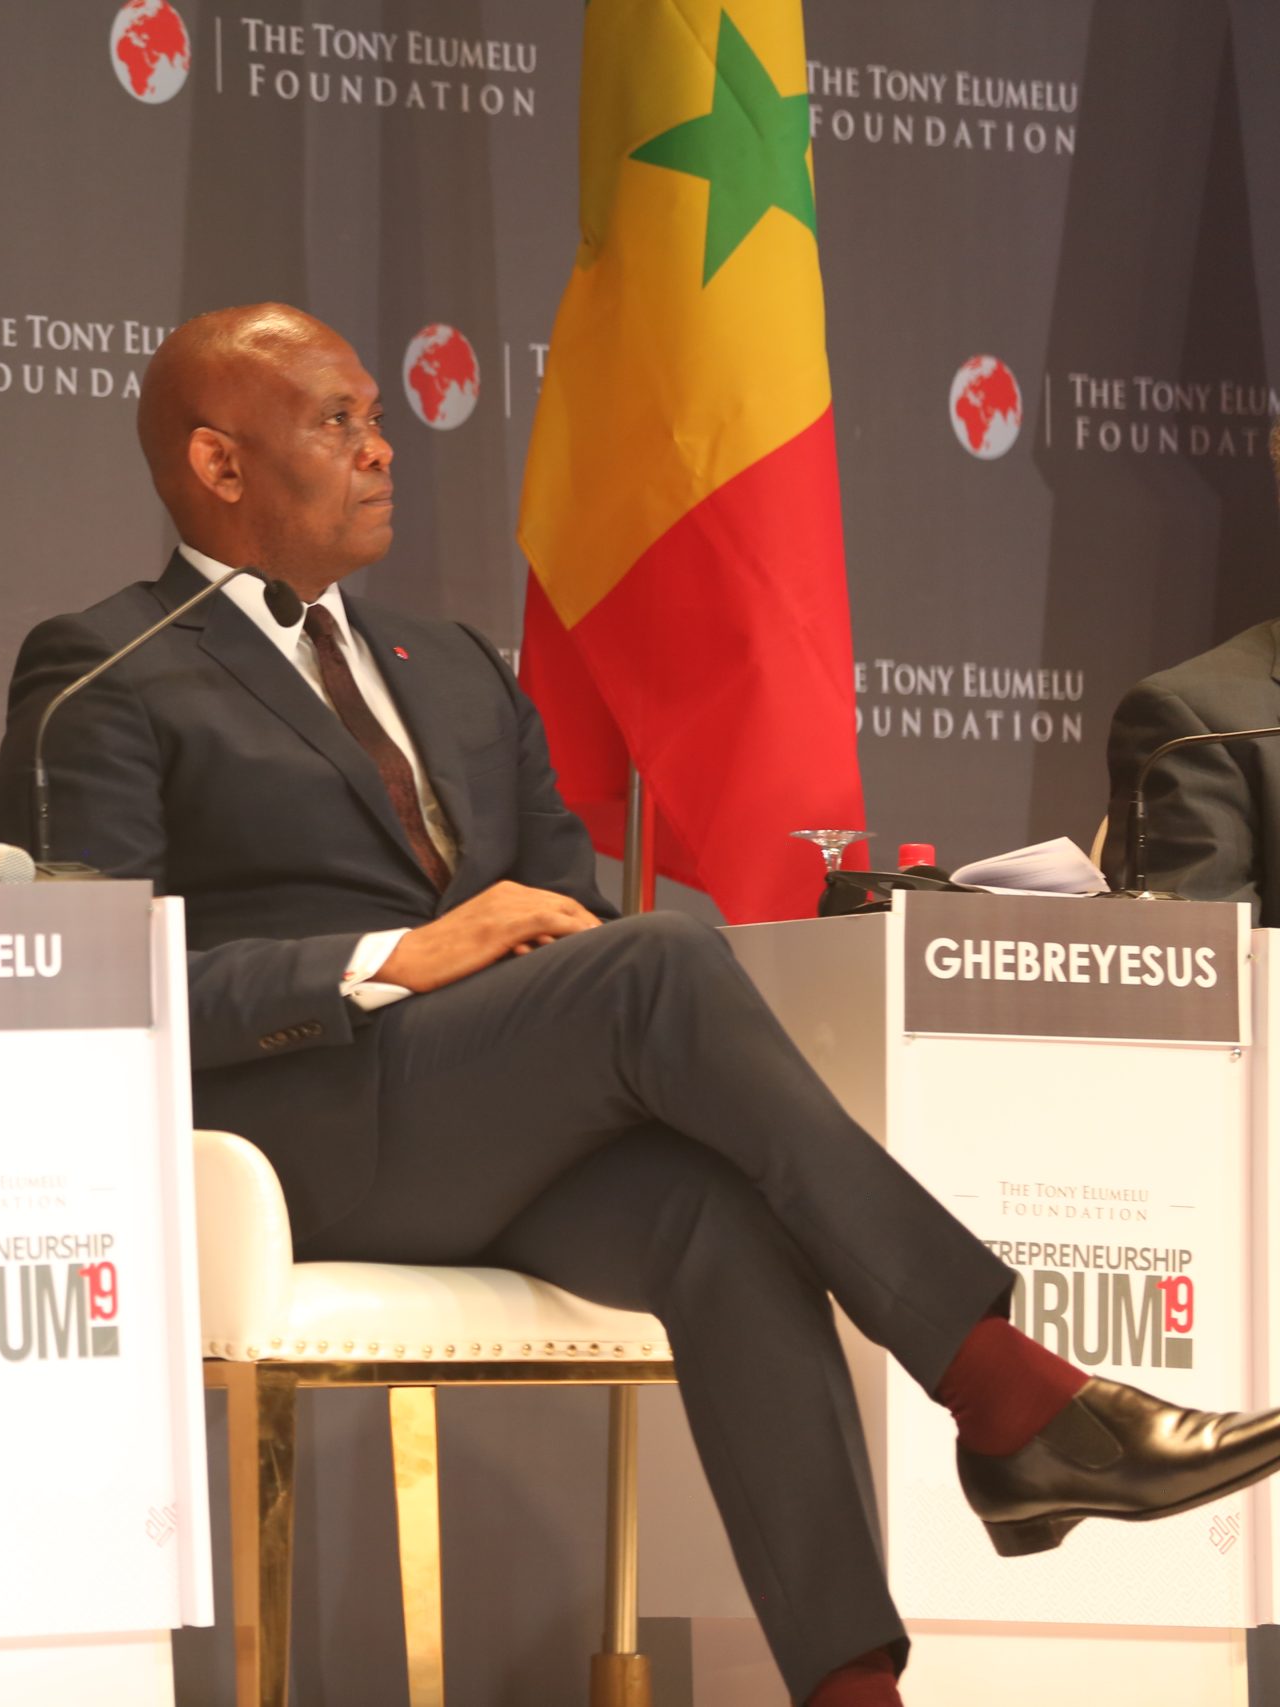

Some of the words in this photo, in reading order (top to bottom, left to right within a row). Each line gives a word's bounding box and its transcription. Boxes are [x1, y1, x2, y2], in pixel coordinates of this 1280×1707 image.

[240, 17, 306, 56] THE
[311, 22, 398, 63] TONY
[406, 30, 537, 73] ELUMELU
[248, 62, 536, 117] FOUNDATION
[806, 60, 861, 98] THE
[866, 64, 947, 104] TONY
[955, 71, 1079, 114] ELUMELU
[809, 103, 1077, 155] FOUNDATION
[25, 314, 115, 353] TONY
[1068, 372, 1126, 410] THE
[1132, 375, 1212, 413] TONY
[874, 658, 954, 697] TONY
[963, 662, 1085, 701] ELUMELU
[925, 937, 1218, 988] GHEBREYESUS
[999, 1181, 1031, 1197] THE
[1035, 1182, 1078, 1199] TONY
[1082, 1185, 1150, 1203] ELUMELU
[1001, 1200, 1148, 1222] FOUNDATION
